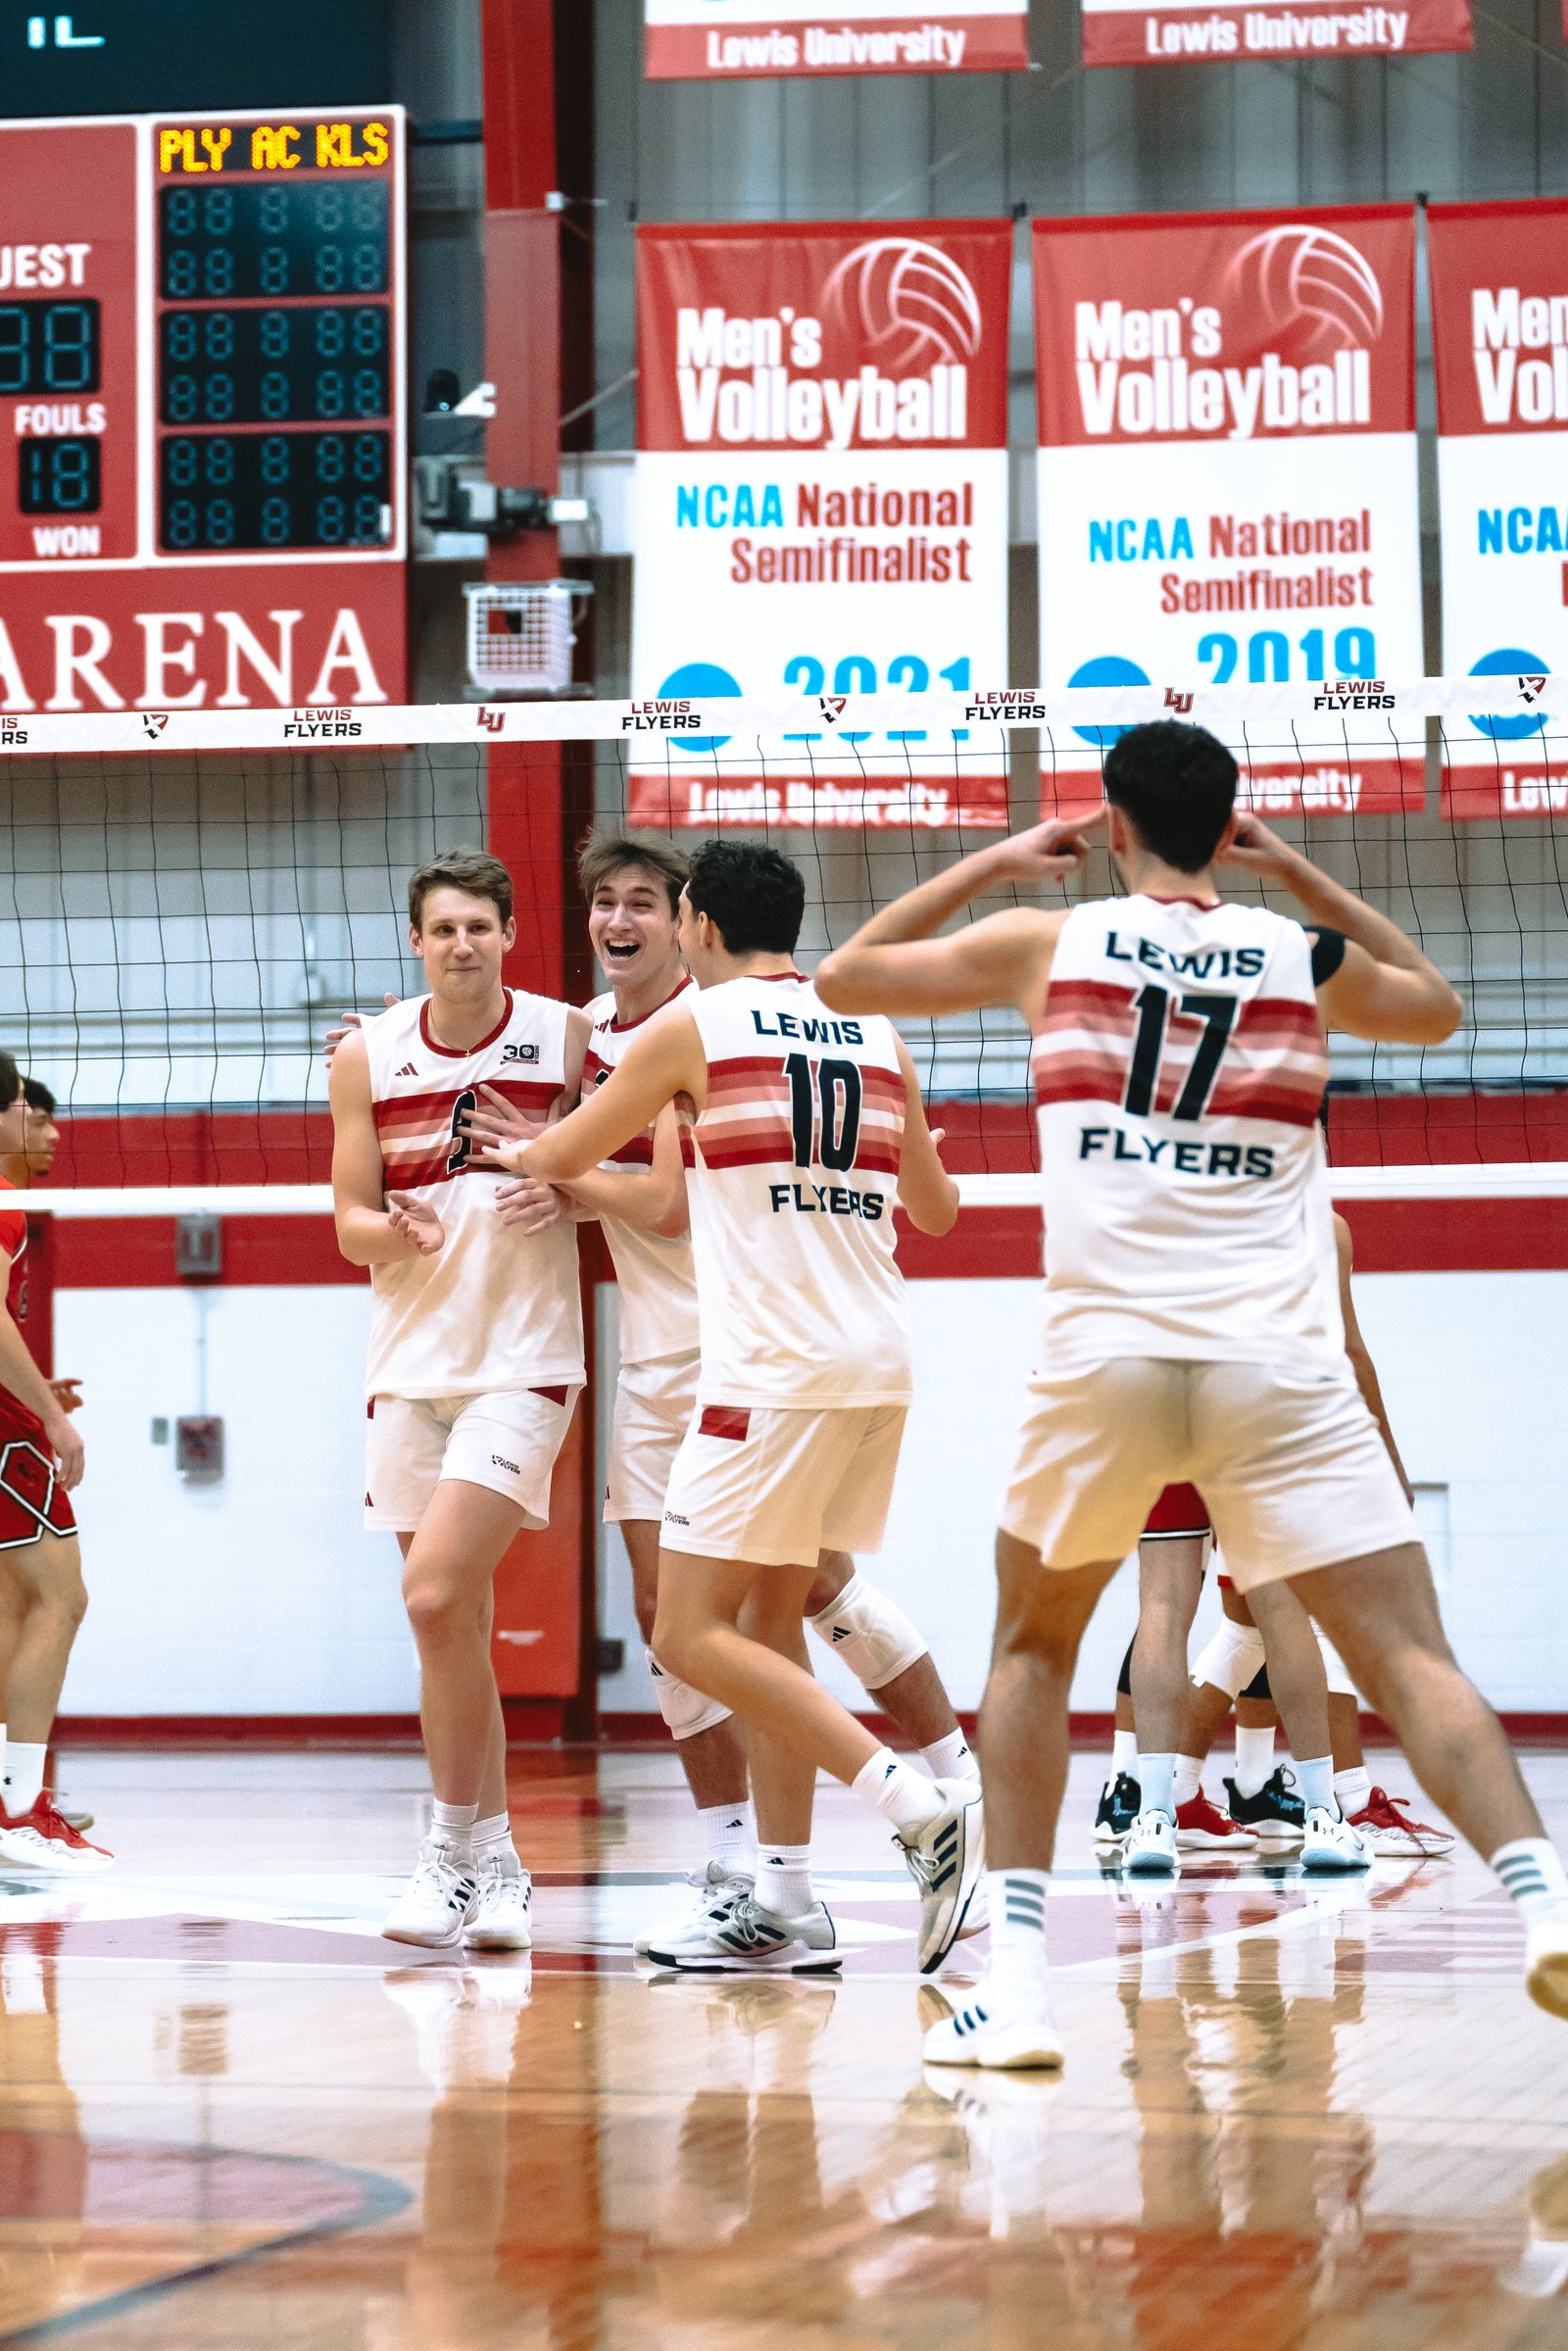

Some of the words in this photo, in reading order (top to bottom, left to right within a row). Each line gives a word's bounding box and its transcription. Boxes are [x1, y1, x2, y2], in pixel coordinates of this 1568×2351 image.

[708, 30, 798, 69] Lewis
[804, 25, 965, 68] University
[1147, 16, 1237, 55] Lewis
[1245, 8, 1408, 51] University
[160, 128, 231, 172] PLY
[251, 125, 301, 170] AC
[316, 122, 389, 168] KLS
[677, 307, 821, 368] Men's
[1076, 297, 1221, 360] Men's
[676, 364, 966, 450] Volleyball
[1076, 349, 1370, 440] Volleyball
[15, 404, 107, 435] FOULS
[676, 483, 784, 528] NCAA
[796, 481, 974, 527] National
[32, 525, 100, 558] WON
[1089, 516, 1195, 563] NCAA
[1208, 508, 1372, 560] National
[1477, 506, 1568, 556] NCA
[730, 536, 973, 584] Semifinalist
[1160, 564, 1375, 614] Semifinalist
[630, 701, 691, 714] LEWIS
[974, 690, 1036, 705] LEWIS
[1313, 695, 1396, 710] FLYERS
[1323, 680, 1386, 695] LEWIS
[283, 723, 363, 738] FLYERS
[293, 709, 353, 722] LEWIS
[621, 714, 702, 731] FLYERS
[964, 704, 1047, 721] FLYERS
[1234, 768, 1362, 812] iversity
[1105, 931, 1265, 979] LEWIS
[750, 1010, 863, 1045] LEWIS
[1124, 981, 1240, 1121] 17
[782, 1053, 862, 1172] 10
[1079, 1126, 1274, 1177] FLYERS
[768, 1184, 884, 1220] FLYERS
